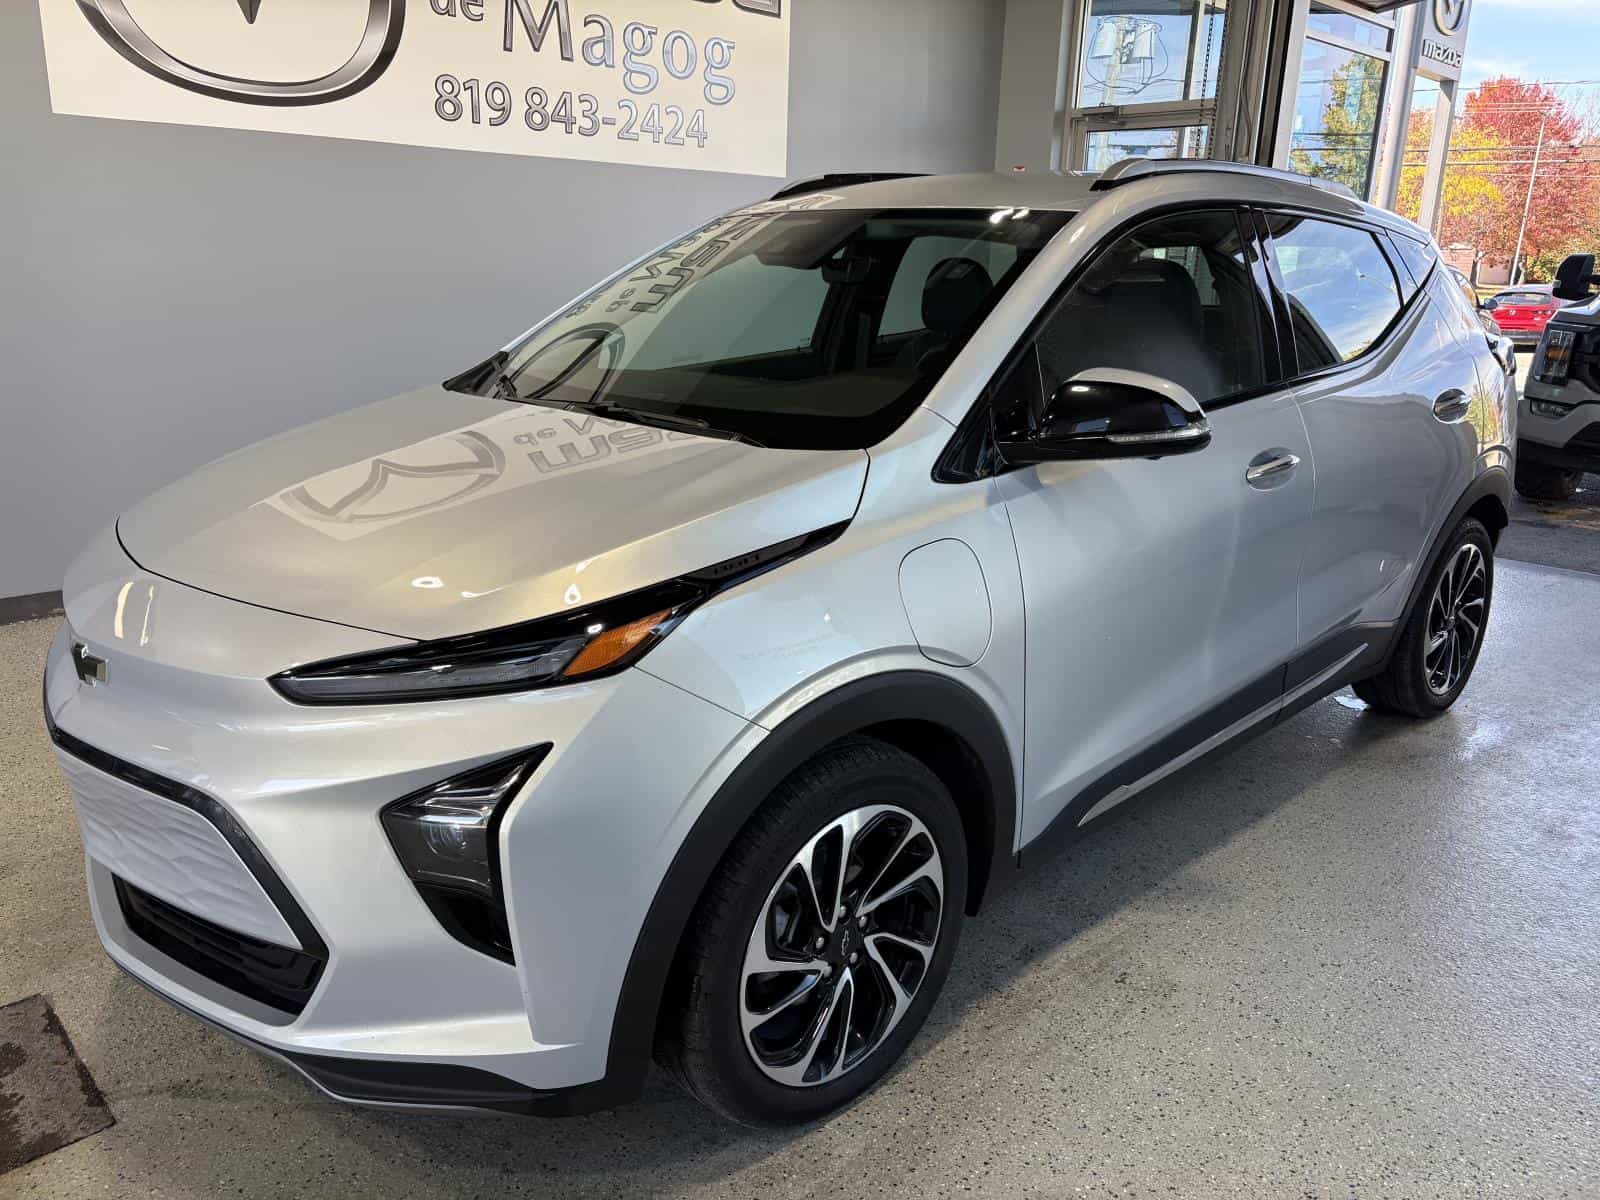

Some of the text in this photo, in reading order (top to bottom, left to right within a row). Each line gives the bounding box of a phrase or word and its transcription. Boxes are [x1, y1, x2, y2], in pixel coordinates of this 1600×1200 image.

[503, 0, 736, 105] Magog
[434, 74, 708, 148] 819 843-2424
